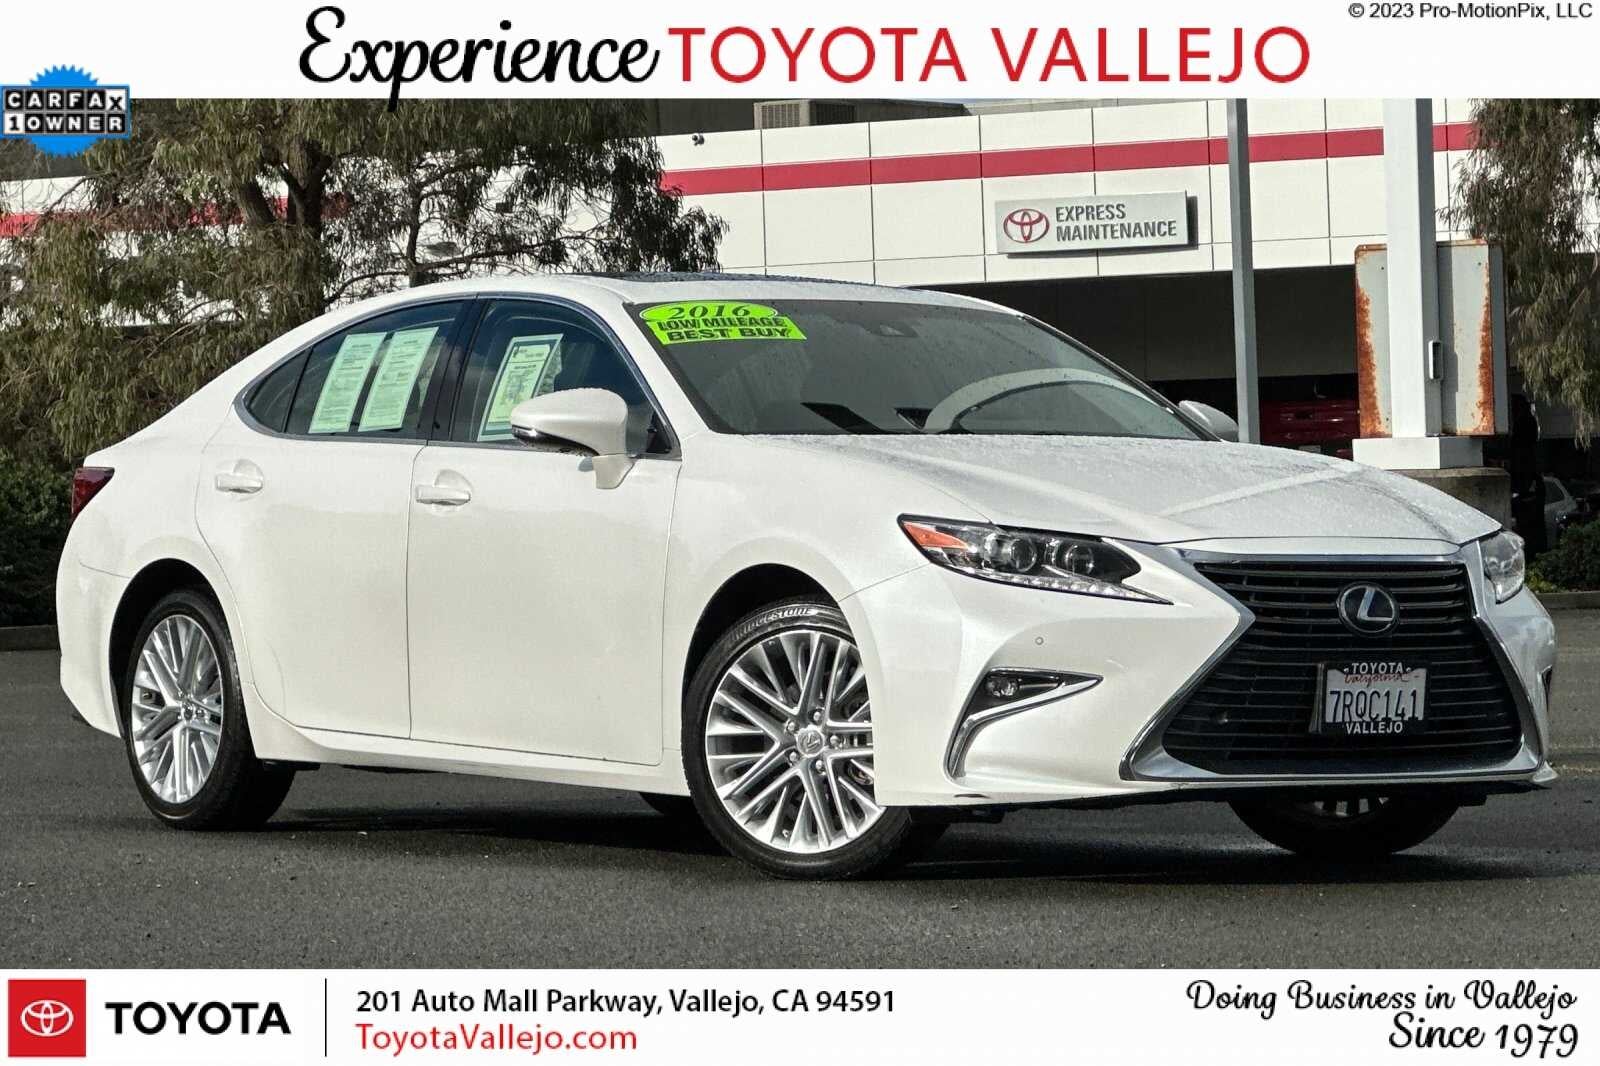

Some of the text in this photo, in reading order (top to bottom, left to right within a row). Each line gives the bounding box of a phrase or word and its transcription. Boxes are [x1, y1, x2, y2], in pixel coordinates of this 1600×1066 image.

[1055, 203, 1126, 222] EXPRESS
[1056, 220, 1177, 242] MAINTENANCE
[670, 304, 751, 320] 2016
[657, 316, 786, 331] LOW MILEAGE
[666, 327, 791, 342] BEST BUY
[1351, 661, 1404, 675] TOYOTA
[1328, 688, 1420, 722] 7RQC141
[1345, 721, 1404, 735] VALLEJO
